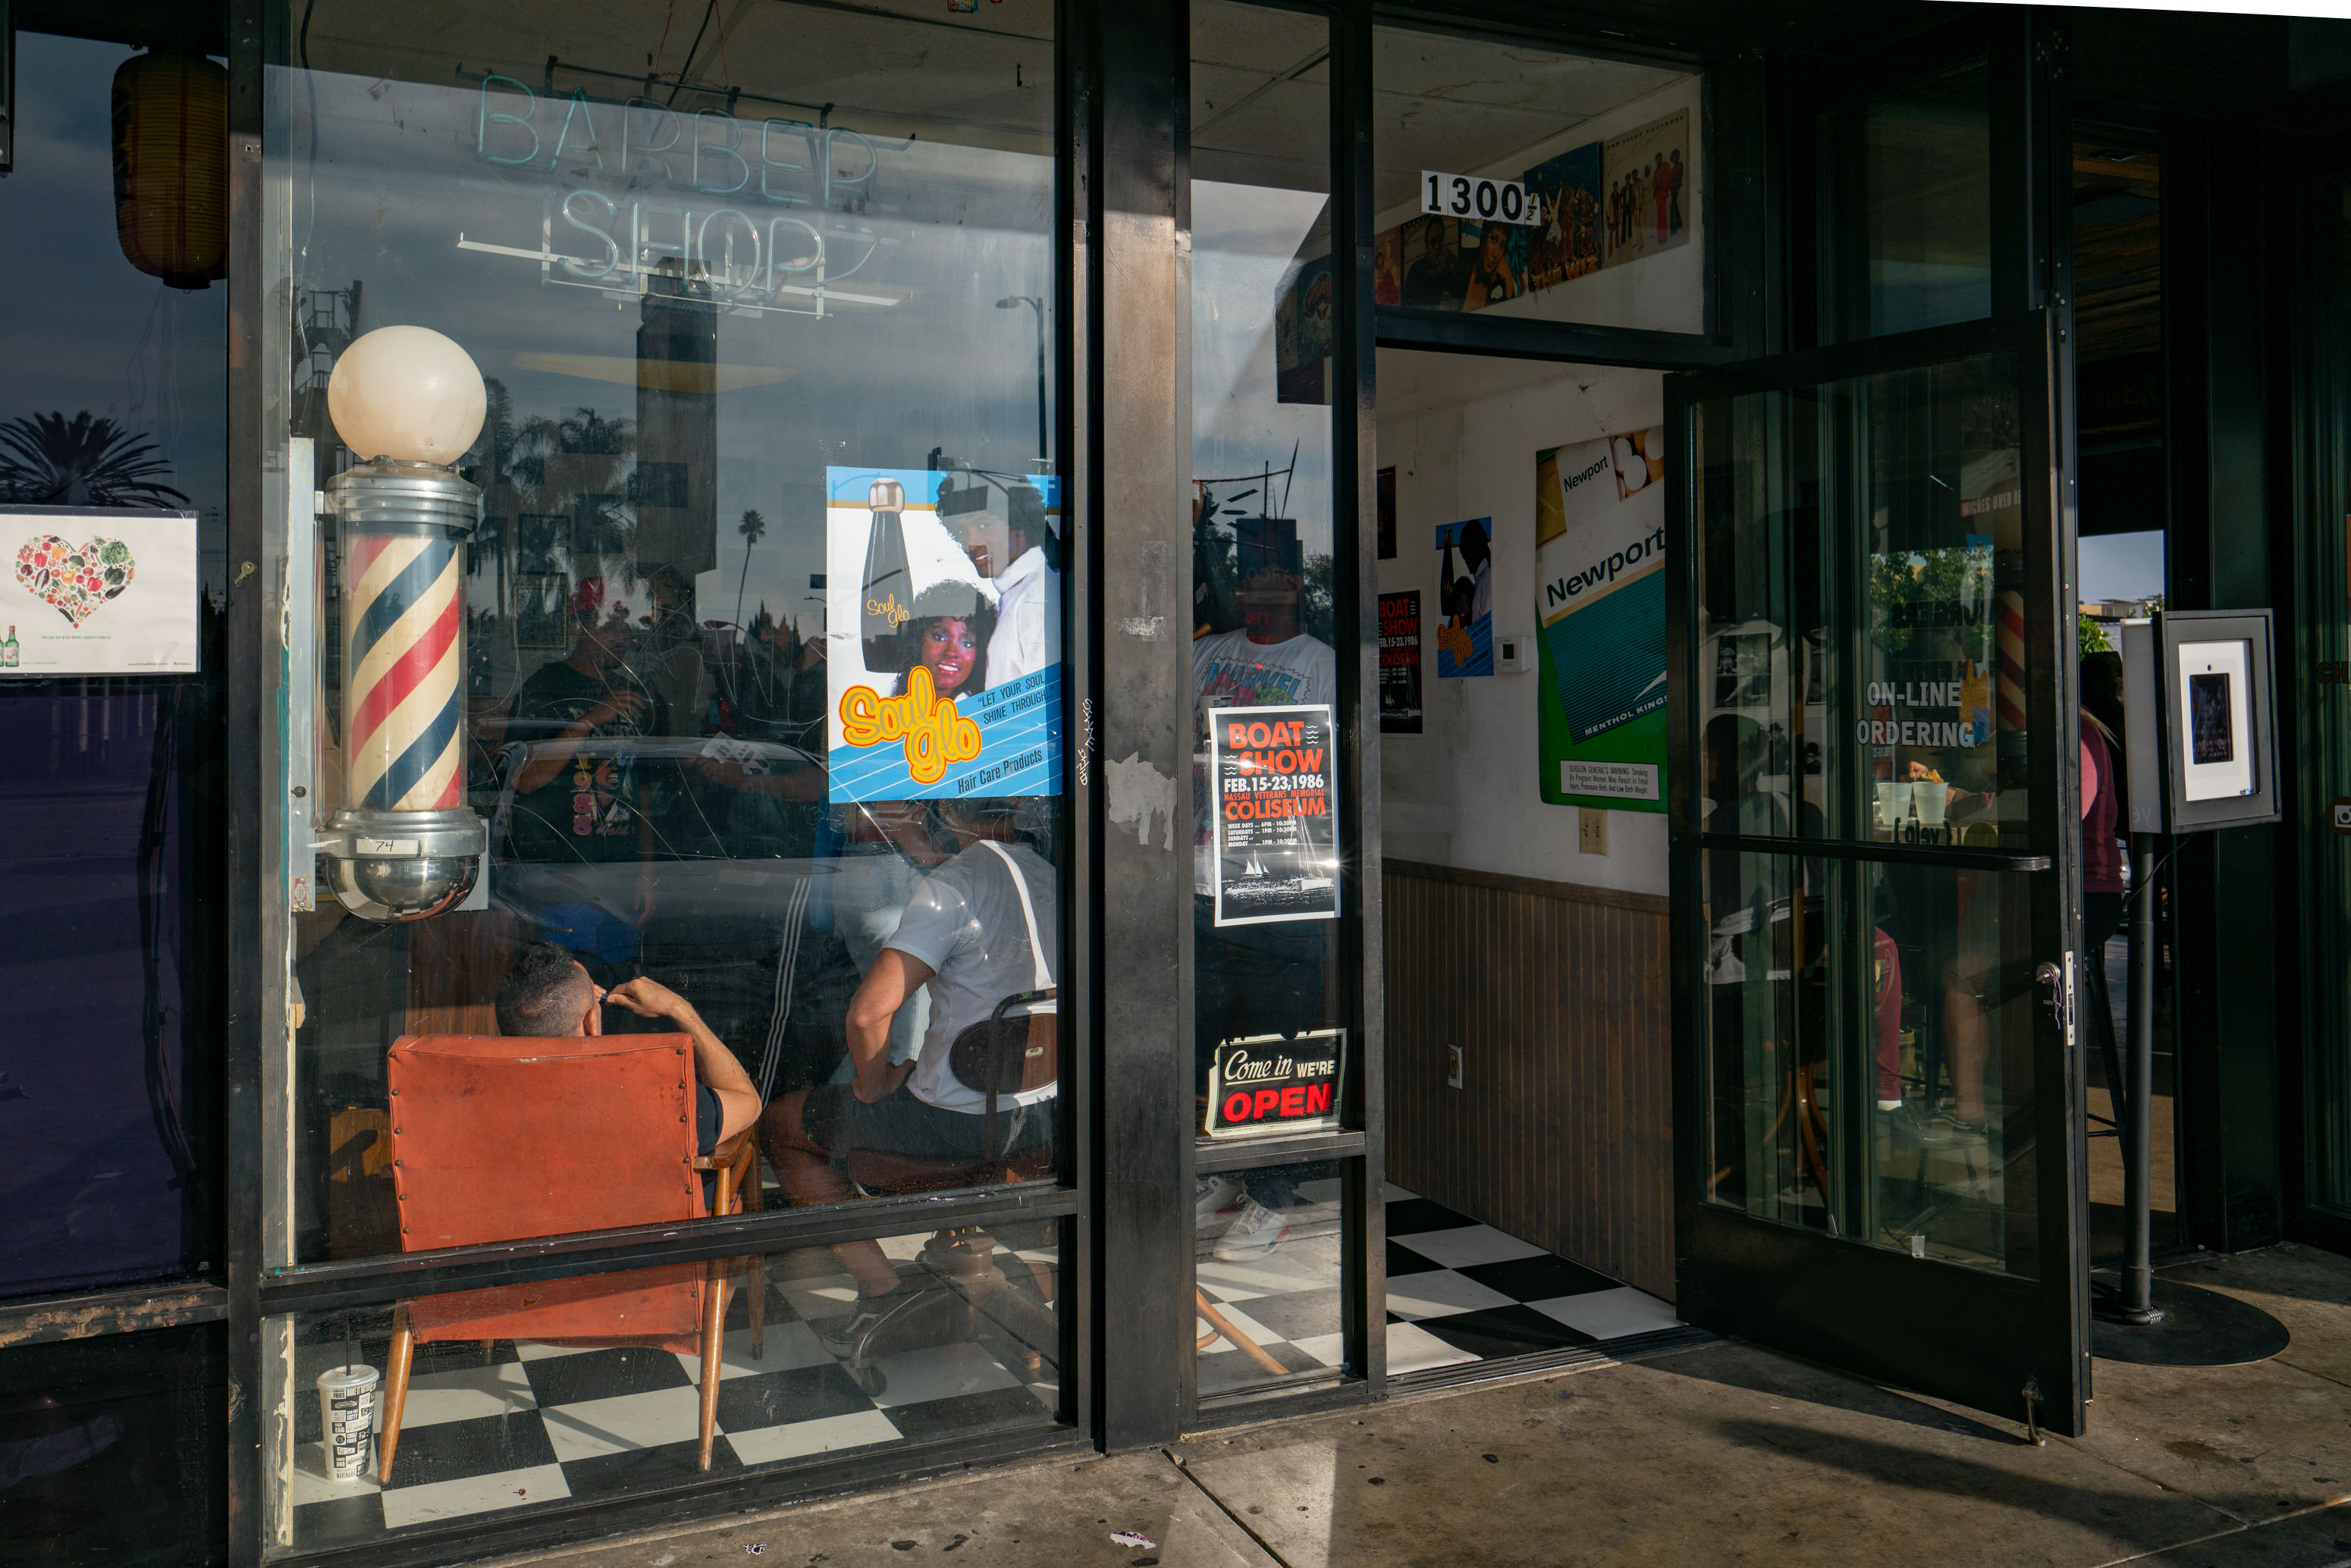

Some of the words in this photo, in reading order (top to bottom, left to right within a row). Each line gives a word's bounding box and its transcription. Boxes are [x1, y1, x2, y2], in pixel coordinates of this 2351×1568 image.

[479, 75, 877, 215] BARBER
[1428, 174, 1523, 221] 1300
[557, 190, 824, 301] SHOP
[1532, 265, 1562, 291] THE
[1565, 254, 1598, 280] WIZ
[1563, 455, 1609, 493] Newport
[1546, 526, 1665, 608] Newport
[867, 592, 896, 619] Soul
[1379, 597, 1411, 619] BOAT
[1383, 617, 1419, 637] SHOW
[1379, 651, 1419, 666] COLISEUM
[1000, 685, 1022, 701] YOUR
[1025, 673, 1045, 691] SOUL
[1204, 661, 1301, 705] MARVEL
[1867, 679, 1962, 707] ON-LINE
[839, 666, 936, 748] Soul
[903, 697, 982, 785] glo
[983, 707, 1008, 724] SHINE
[1584, 710, 1634, 736] MENTHOL
[1228, 721, 1305, 749] BOAT
[1857, 718, 1976, 749] ORDERING
[958, 774, 977, 795] Hair
[979, 767, 1001, 785] Care
[1003, 749, 1043, 776] Products
[1238, 748, 1323, 776] SHOW
[1631, 768, 1648, 777] Smoking
[1575, 773, 1592, 782] Pregnant
[1608, 776, 1617, 784] May
[1618, 776, 1631, 784] Result
[1223, 792, 1251, 801] NASSAU
[1254, 790, 1287, 800] VETERANS
[1290, 788, 1325, 798] MEMORIAL
[1226, 797, 1326, 820] COLISEUM
[375, 839, 394, 852] 74
[1224, 1049, 1272, 1080] Come
[1274, 1055, 1293, 1077] in
[1296, 1059, 1336, 1078] WE'RE
[1223, 1082, 1332, 1122] OPEN
